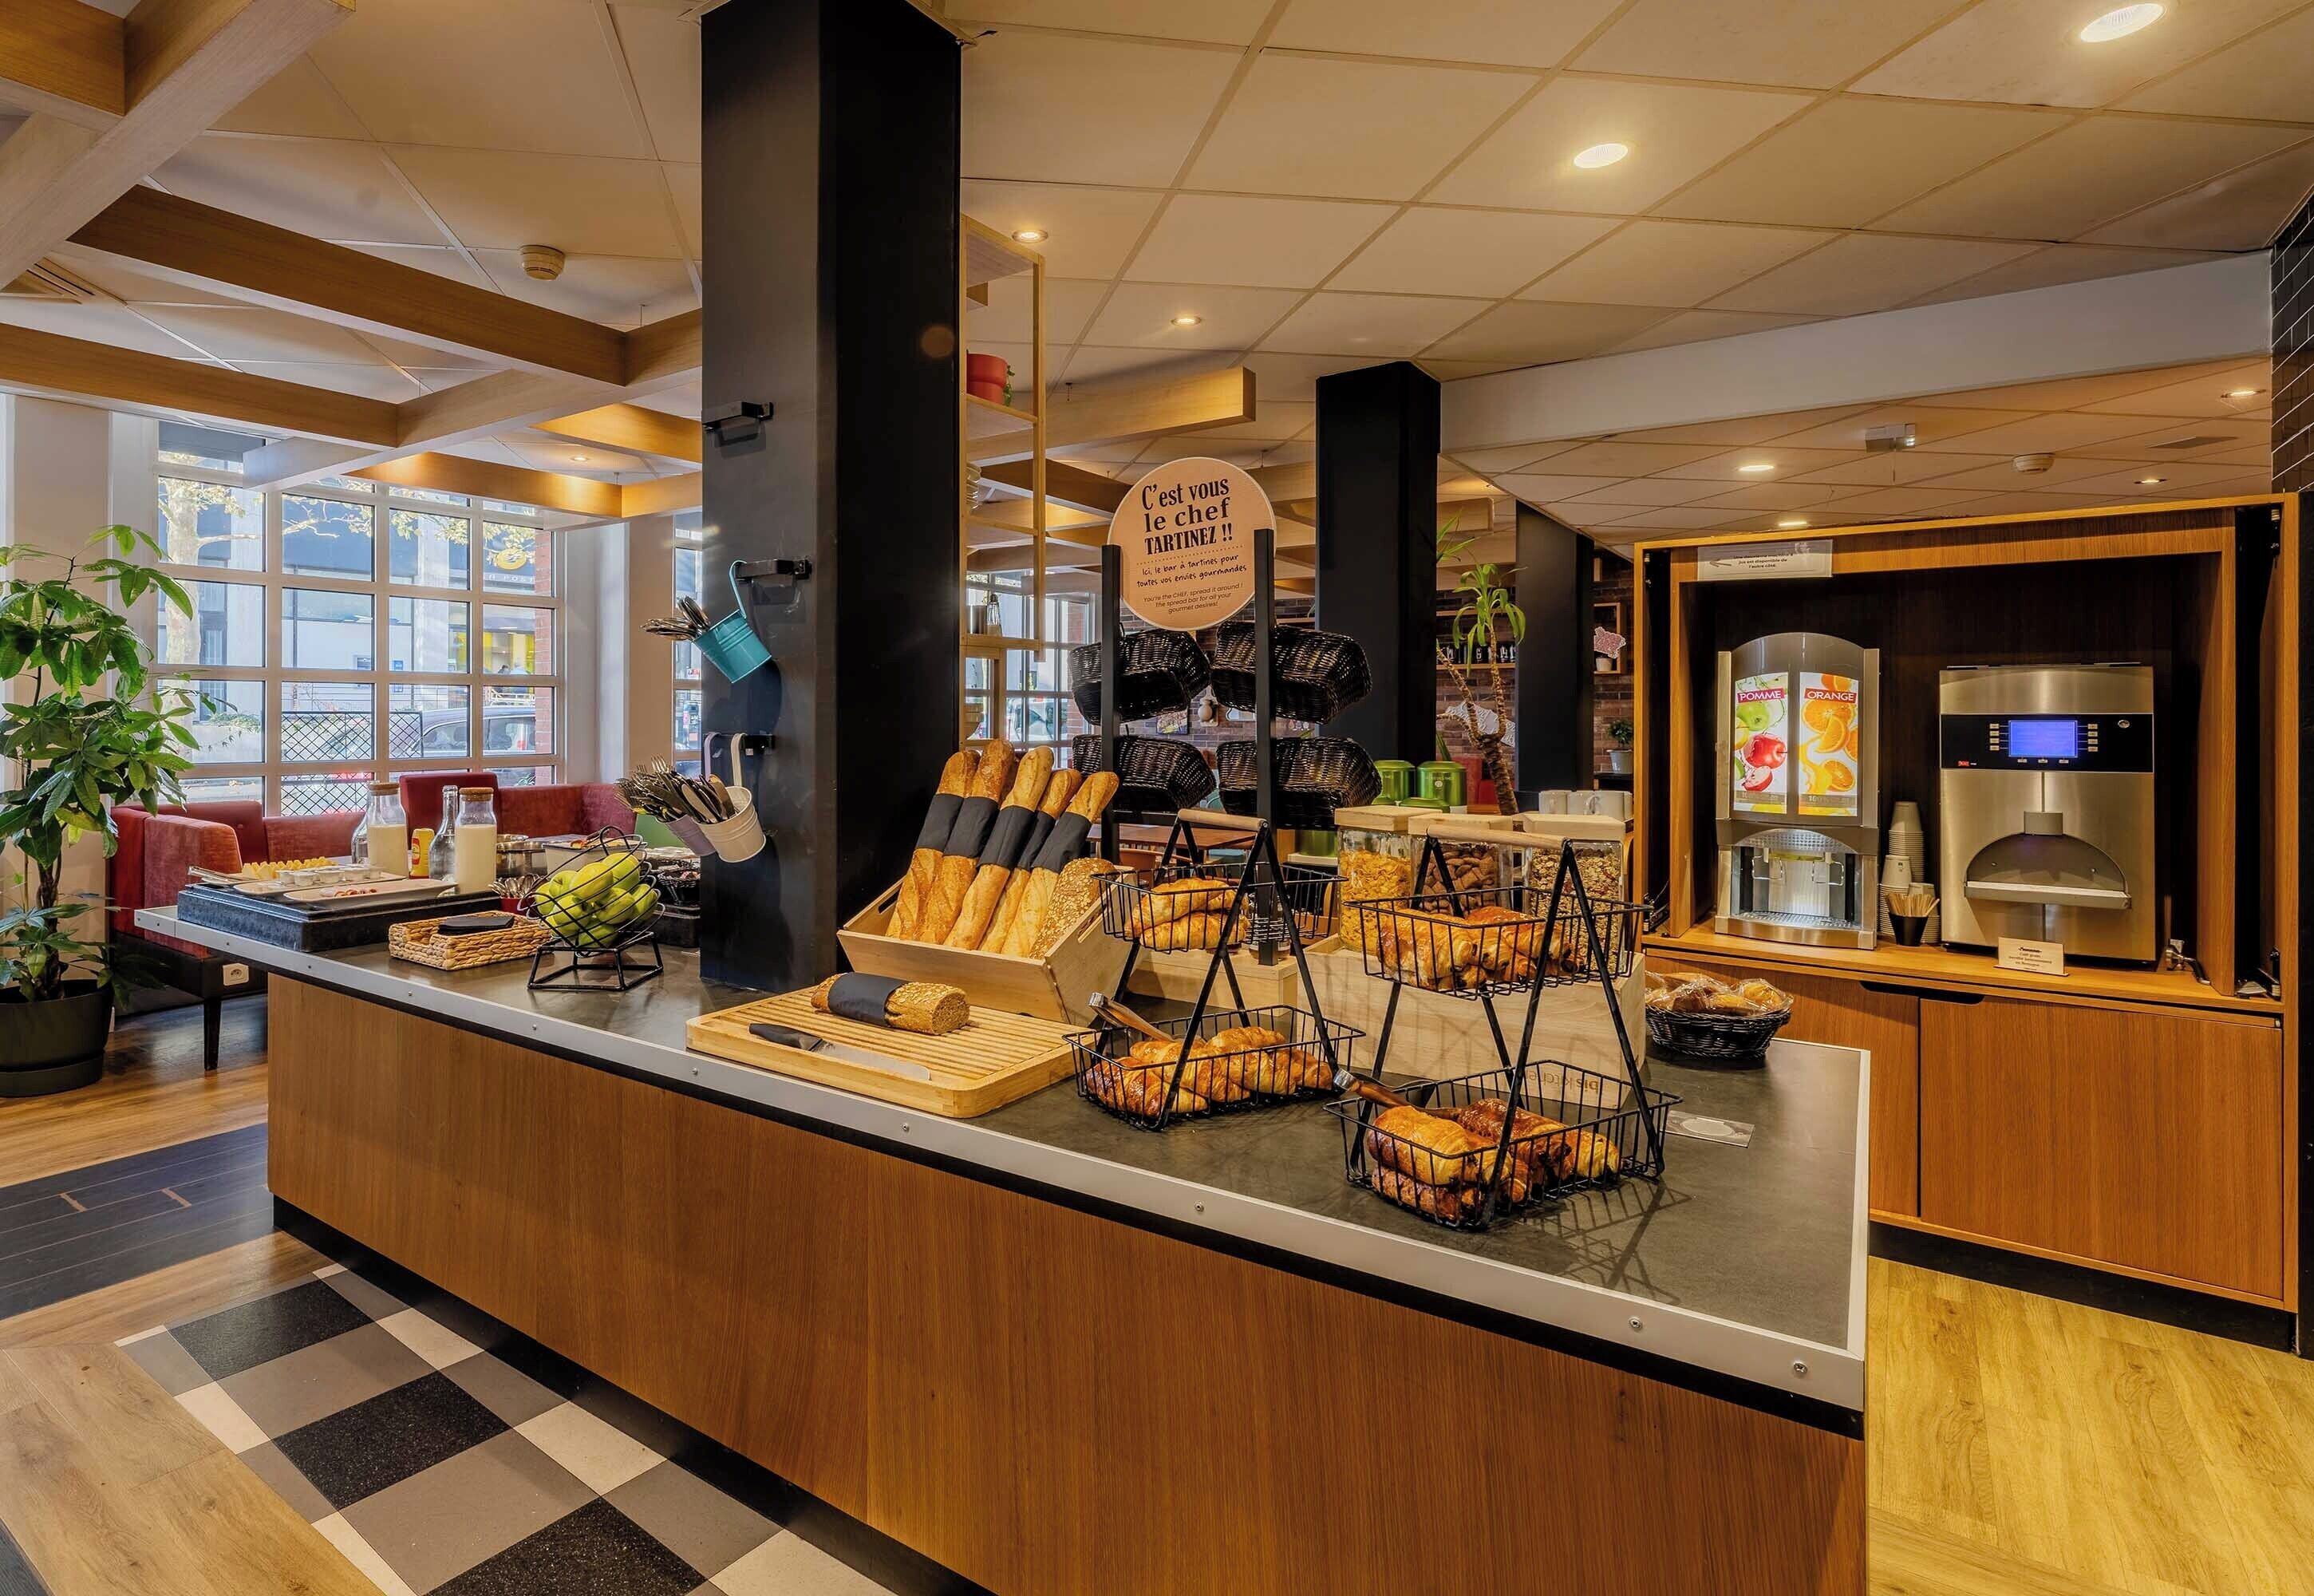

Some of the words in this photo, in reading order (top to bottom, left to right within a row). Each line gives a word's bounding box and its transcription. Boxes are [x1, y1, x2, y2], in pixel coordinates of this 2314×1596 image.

[1189, 479, 1229, 501] vous
[1144, 513, 1167, 533] le
[1175, 496, 1230, 527] chef
[1144, 526, 1217, 555] TARTINEZ
[1222, 523, 1233, 542] !!
[1180, 561, 1186, 570] à
[1220, 555, 1239, 565] pour
[1137, 578, 1158, 588] toutes
[1175, 571, 1197, 583] envies
[1199, 564, 1246, 580] gourmandes
[1190, 587, 1210, 597] spread
[1217, 583, 1240, 591] around
[1167, 598, 1187, 608] spread
[1217, 591, 1232, 601] your
[1168, 604, 1194, 614] gourmet
[1194, 601, 1218, 610] desires!
[1740, 690, 1782, 701] POMME
[1807, 691, 1854, 701] ORANGE
